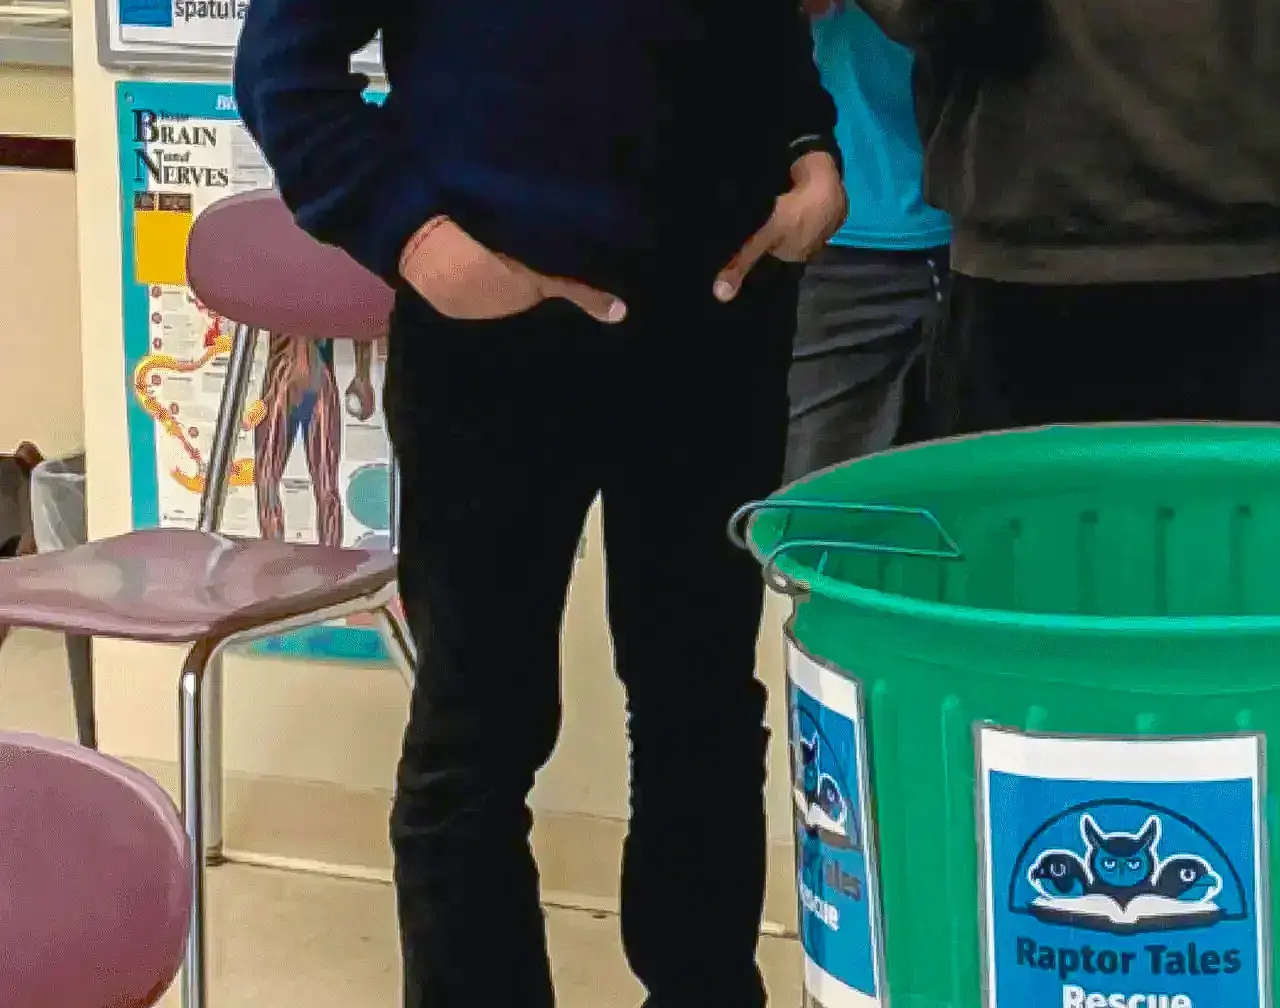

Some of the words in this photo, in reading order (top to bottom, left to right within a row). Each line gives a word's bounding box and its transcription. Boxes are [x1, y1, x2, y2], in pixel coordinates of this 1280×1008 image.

[1017, 937, 1135, 979] Raptor
[1144, 942, 1241, 975] Tales
[1063, 984, 1192, 1008] Rescue
